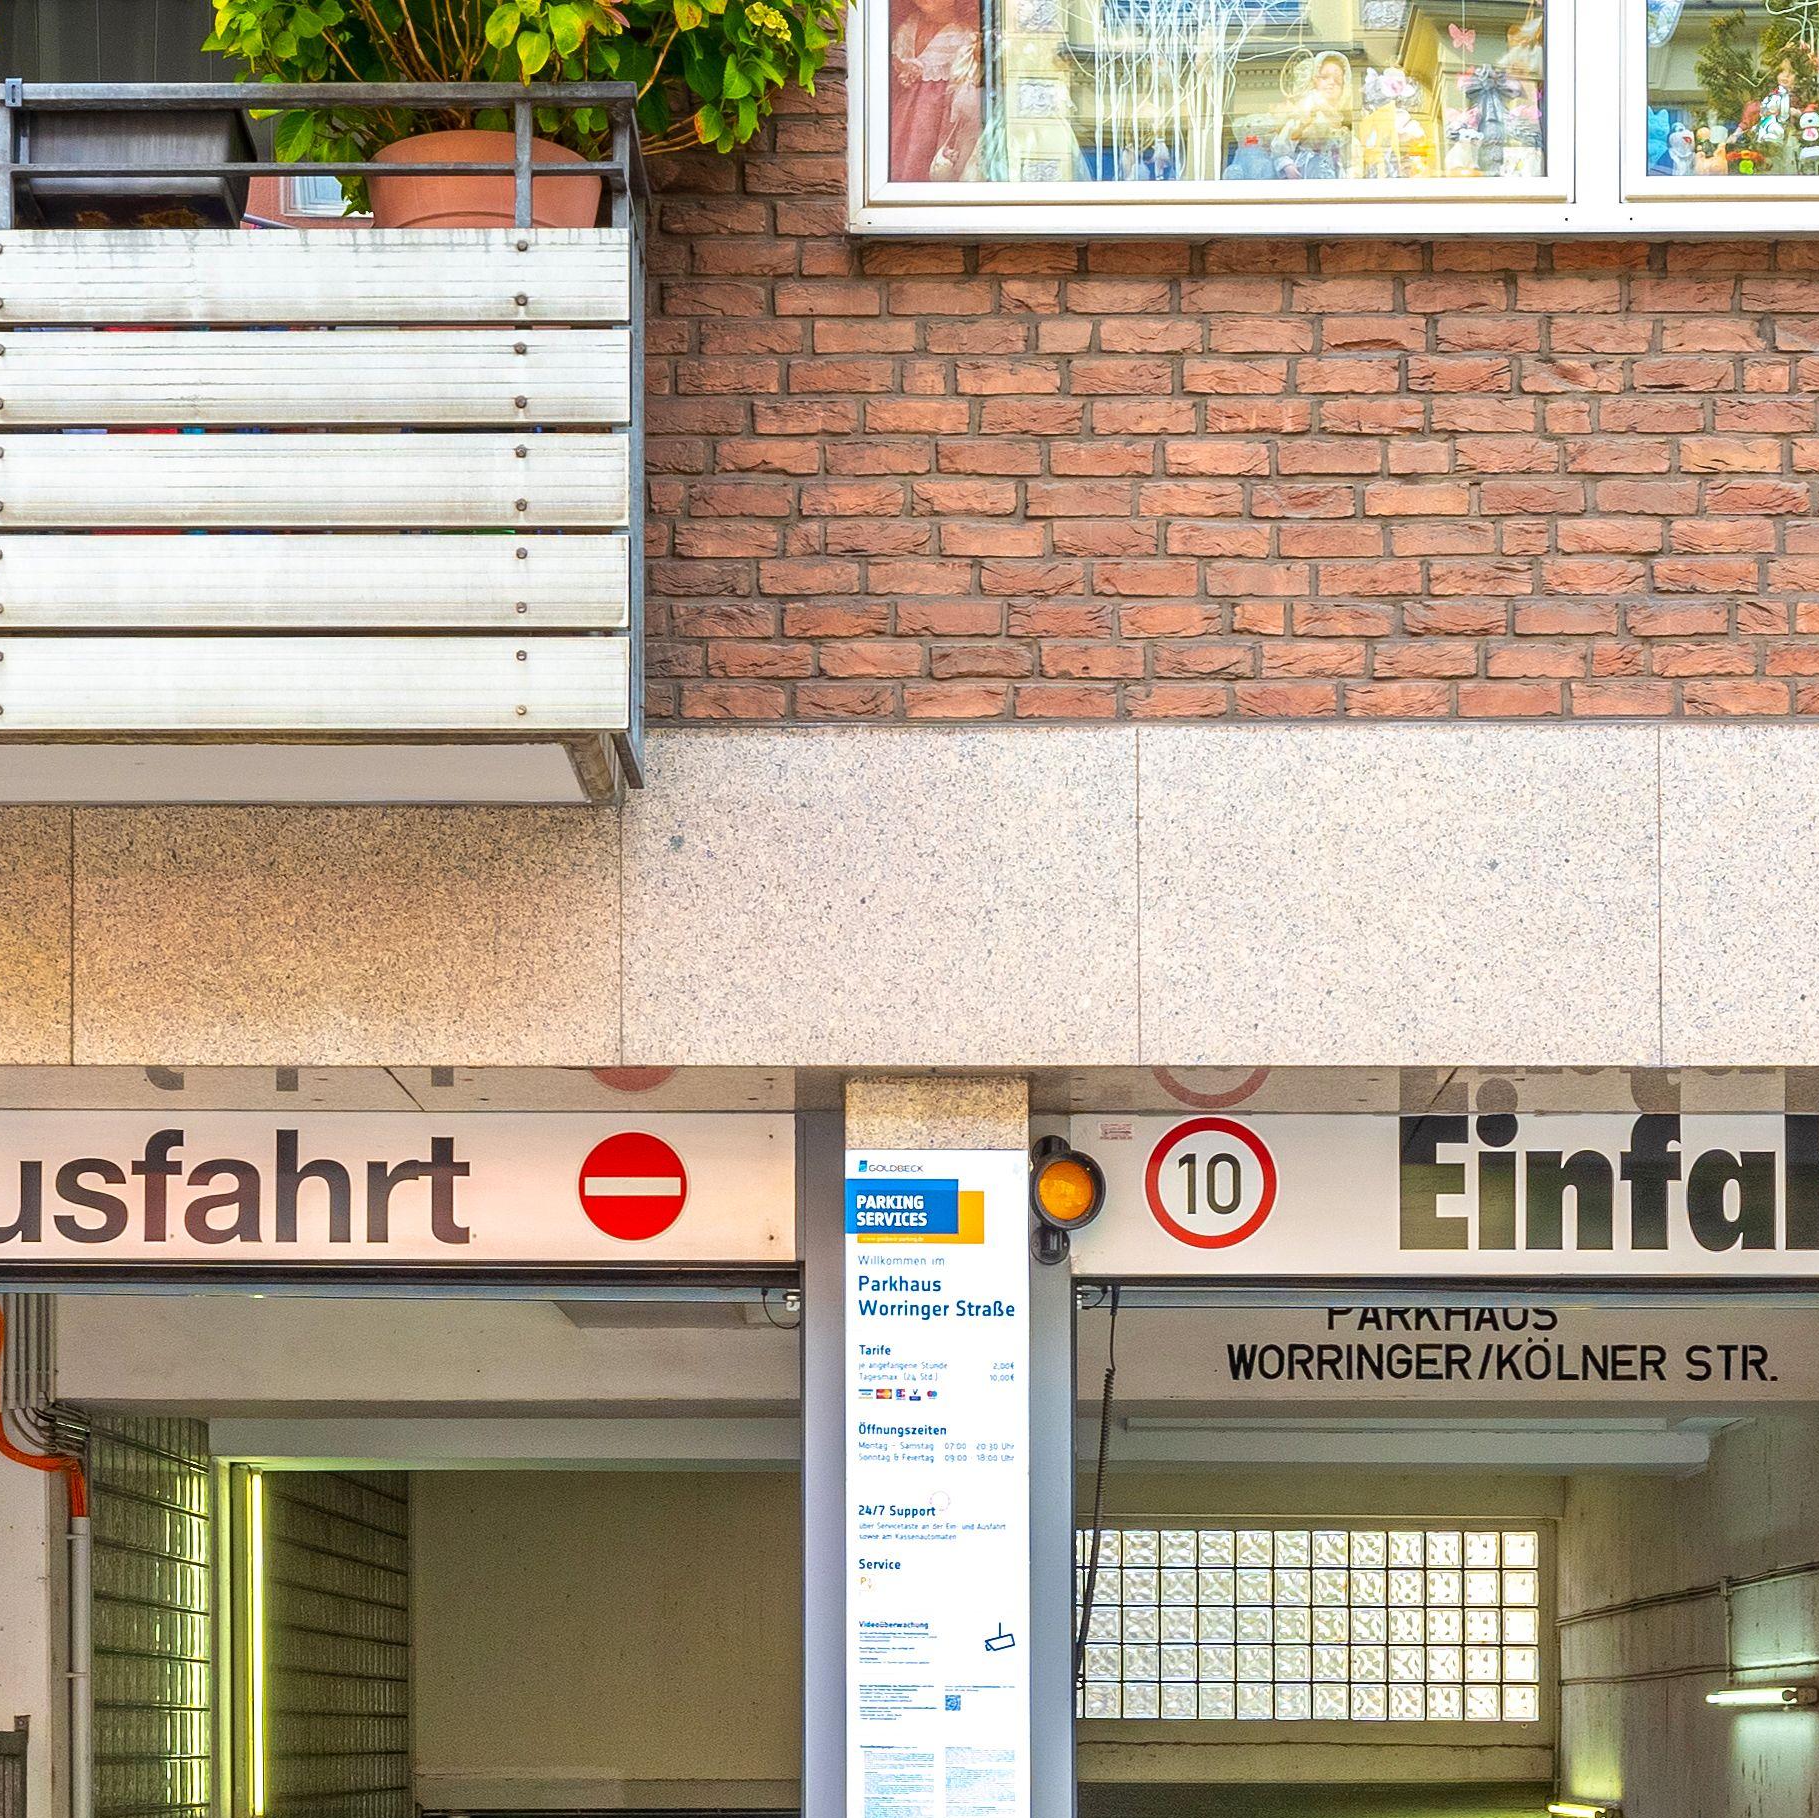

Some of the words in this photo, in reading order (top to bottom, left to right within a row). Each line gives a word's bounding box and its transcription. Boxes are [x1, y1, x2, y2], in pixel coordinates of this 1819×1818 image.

[1178, 1152, 1242, 1215] 10
[856, 1194, 924, 1210] PARKING
[856, 1211, 928, 1227] SERVICES
[858, 1256, 926, 1265] Willkommen
[859, 1276, 941, 1292] Parkhaus
[859, 1300, 949, 1320] Worringer
[956, 1300, 1015, 1317] Straße
[1327, 1308, 1557, 1331] PARKHAUS
[859, 1345, 891, 1355] Tarife
[1227, 1337, 1666, 1380] WORRINGER/KÖLNER
[1686, 1345, 1778, 1381] STR.
[869, 1361, 918, 1371] angefangene
[993, 1362, 1014, 1370] 2,00€
[990, 1373, 1014, 1383] 10,00€
[859, 1422, 946, 1437] Öffnungszeiten
[859, 1441, 889, 1451] Montag
[900, 1442, 934, 1451] Samstag
[859, 1453, 890, 1462] Sonntag
[902, 1453, 934, 1463] Feiertag
[1001, 1455, 1014, 1463] Uhr
[859, 1505, 885, 1515] 24/7
[890, 1505, 936, 1518] Support
[859, 1559, 901, 1569] Service
[859, 1621, 929, 1630] Videoüberwachung
